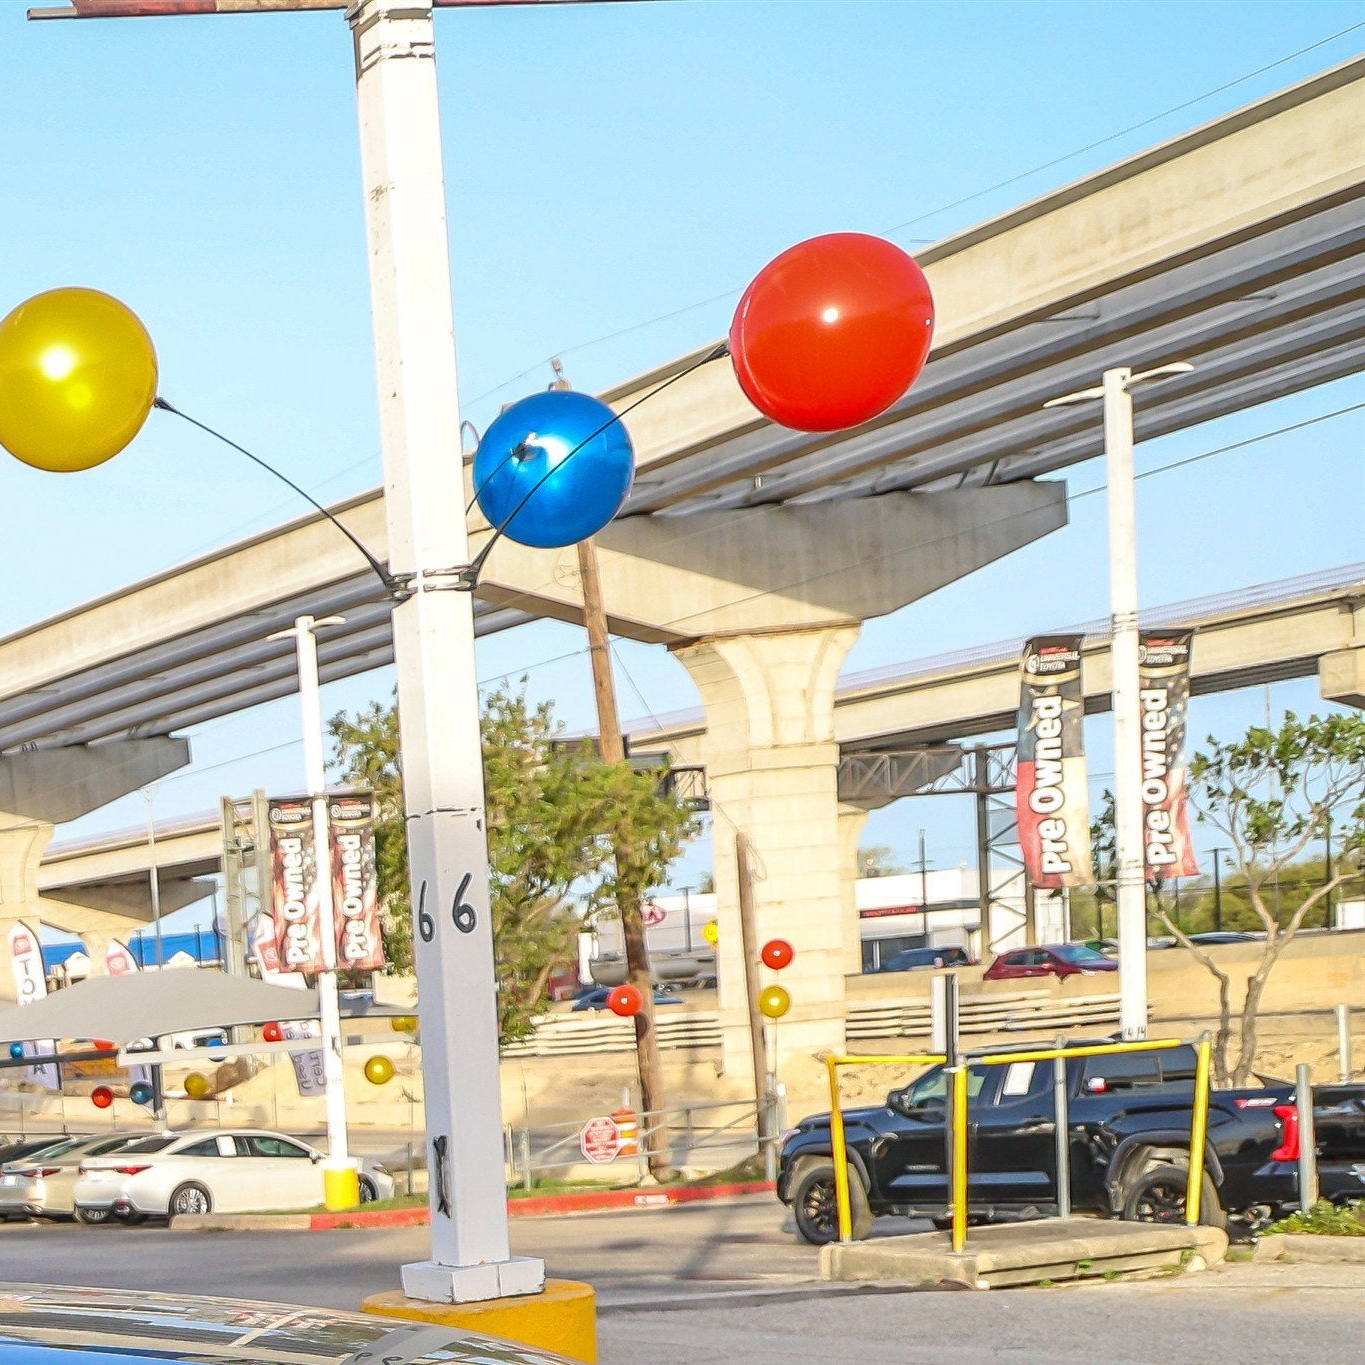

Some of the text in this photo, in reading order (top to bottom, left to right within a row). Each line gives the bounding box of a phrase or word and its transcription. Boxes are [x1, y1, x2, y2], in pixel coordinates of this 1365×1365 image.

[1028, 695, 1066, 815] Owned
[1140, 688, 1178, 866] Pre Owned
[336, 833, 364, 917] Owned
[1036, 817, 1073, 875] Pre
[277, 837, 306, 921] Owned
[418, 879, 436, 943] 6
[452, 872, 478, 934] 6
[284, 921, 311, 965] Pre
[343, 918, 370, 961] Pre
